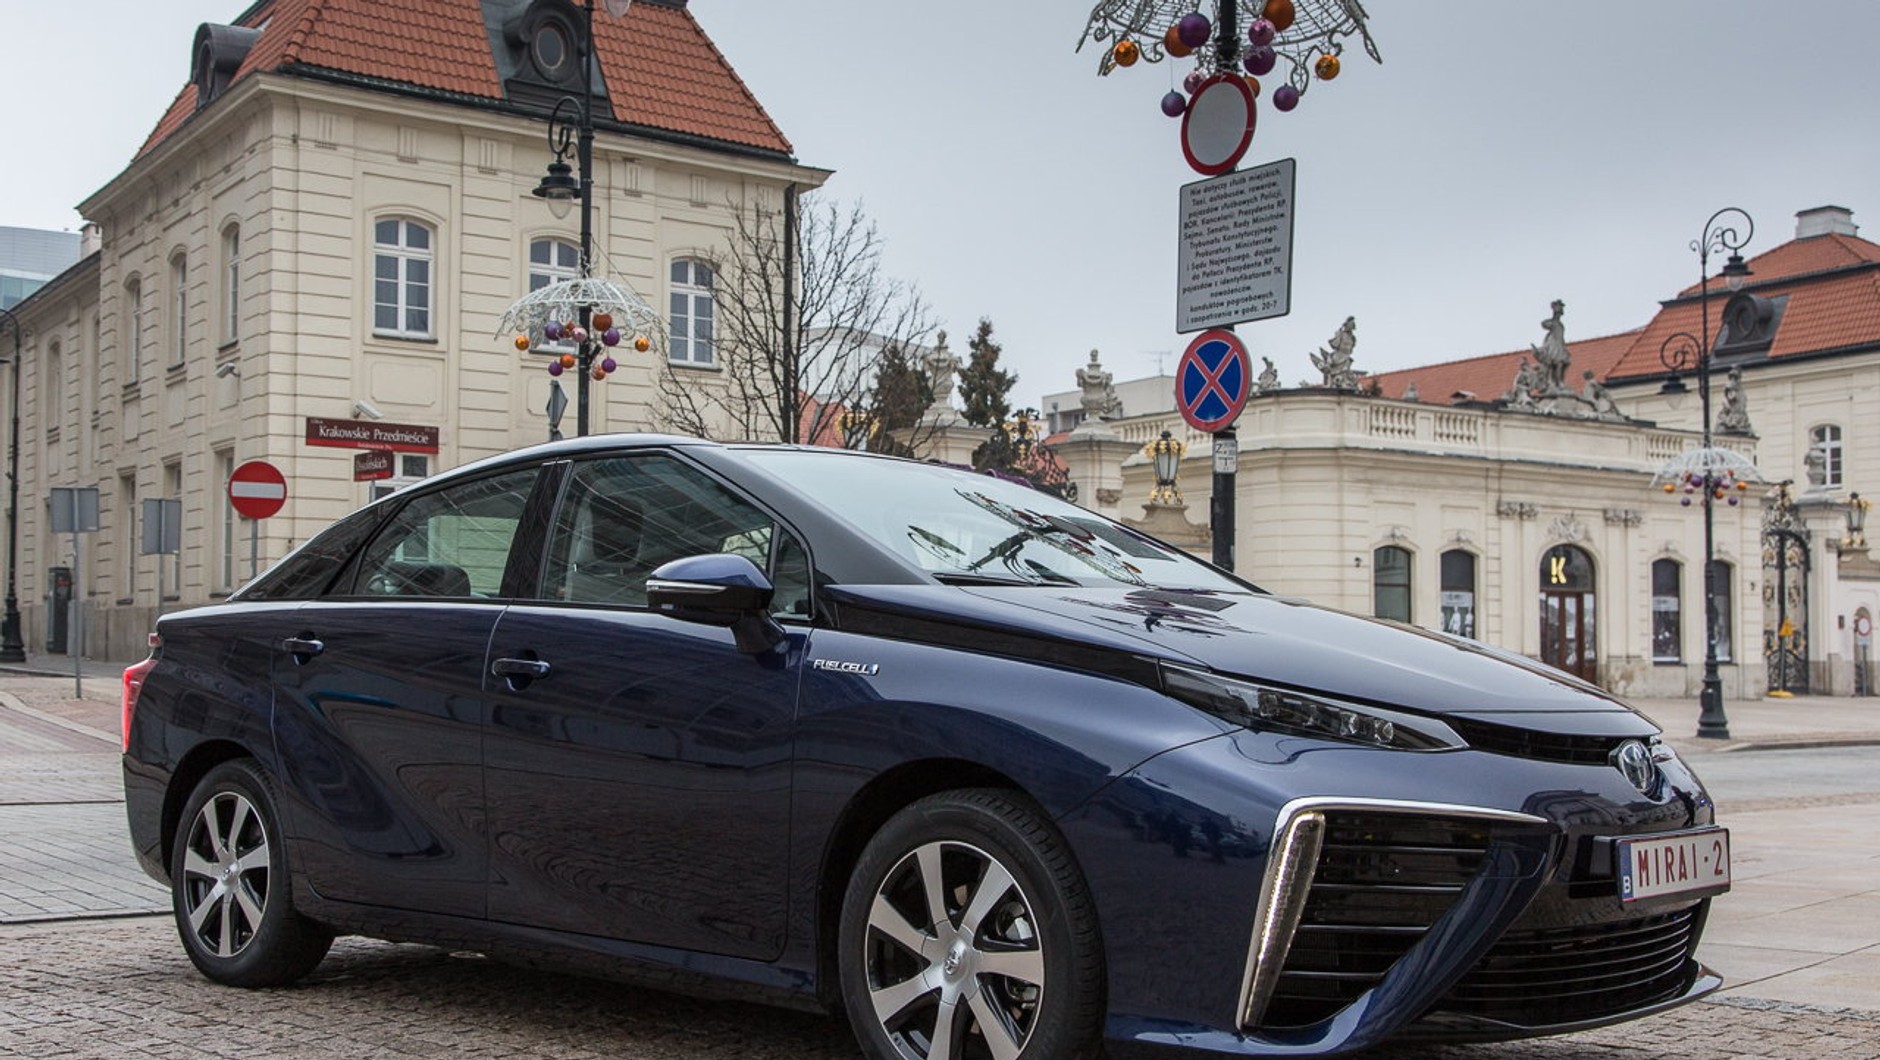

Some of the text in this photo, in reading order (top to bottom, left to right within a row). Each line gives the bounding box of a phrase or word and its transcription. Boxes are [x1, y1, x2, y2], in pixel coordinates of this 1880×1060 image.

[1204, 183, 1227, 194] dotyczy
[1238, 203, 1274, 216] Prezydenta
[1226, 262, 1262, 273] Prezydenta
[319, 425, 370, 439] Krakowskie
[373, 428, 429, 444] Przedmieście
[1623, 876, 1631, 893] B
